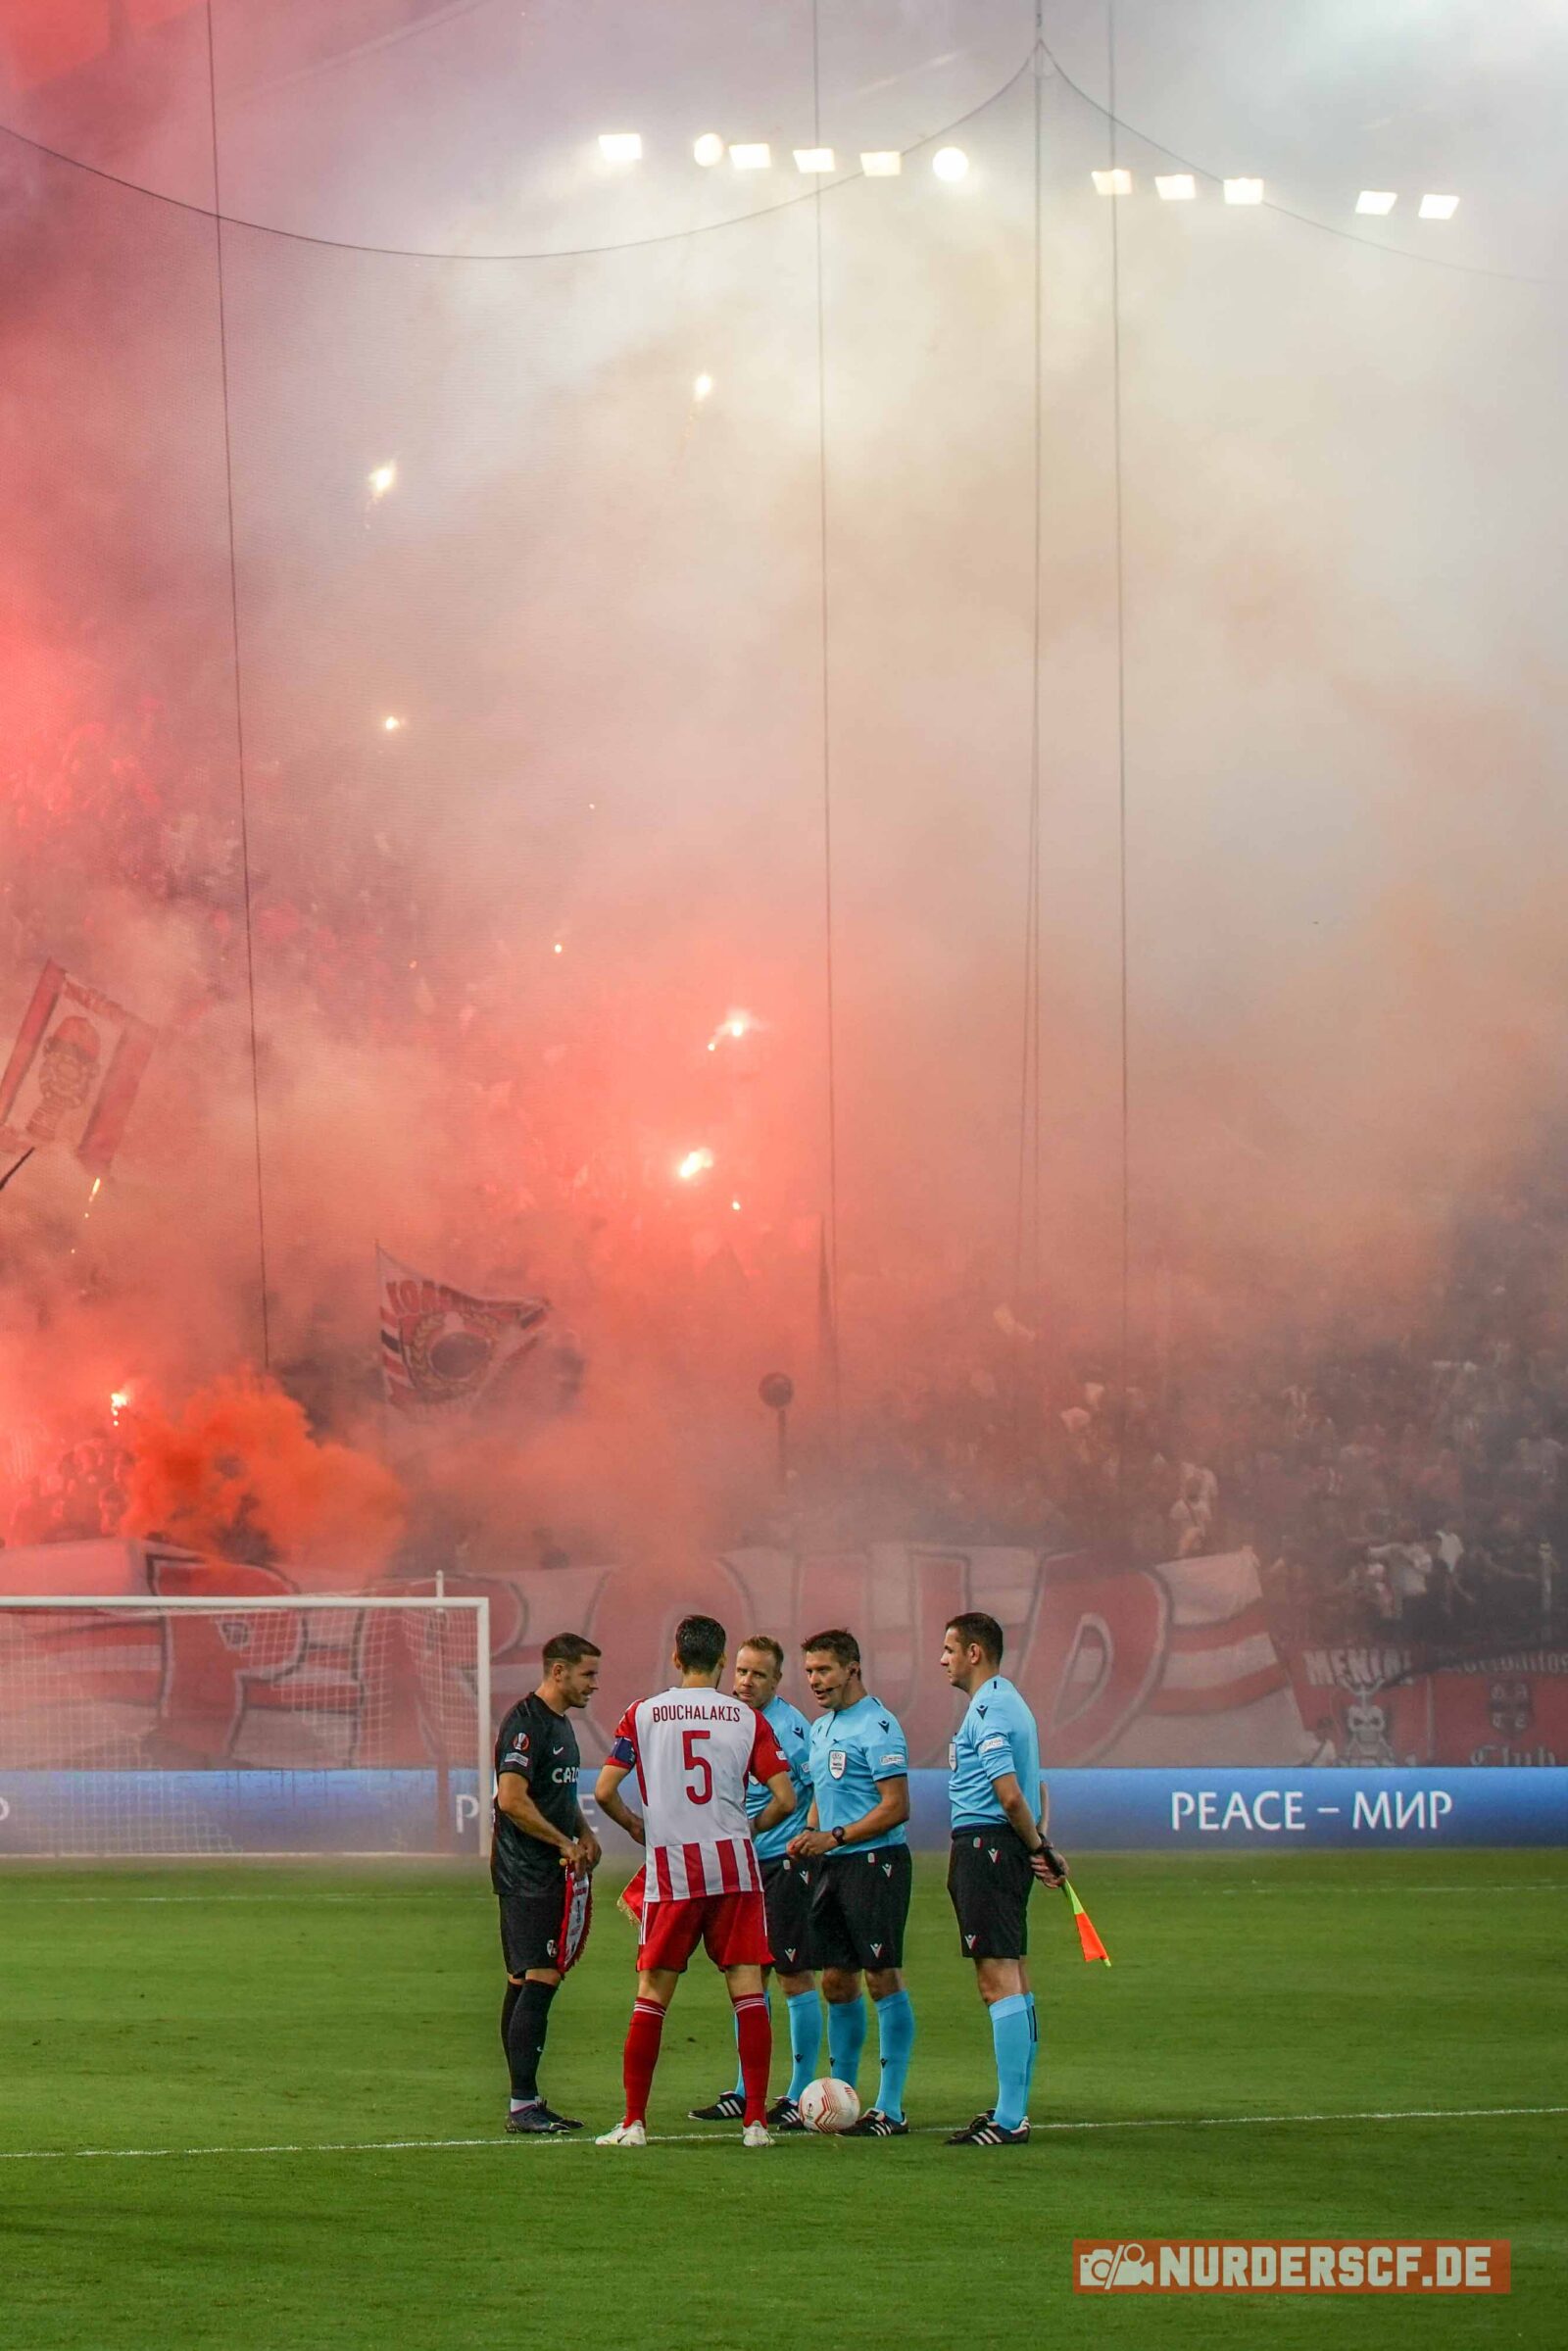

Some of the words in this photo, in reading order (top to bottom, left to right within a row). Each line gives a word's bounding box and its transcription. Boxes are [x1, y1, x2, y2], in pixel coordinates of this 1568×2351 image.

[653, 1705, 740, 1723] BOUCHALAKIS
[682, 1731, 713, 1805] 5
[1170, 1790, 1306, 1832] PEACE
[1352, 1790, 1453, 1830] МИР
